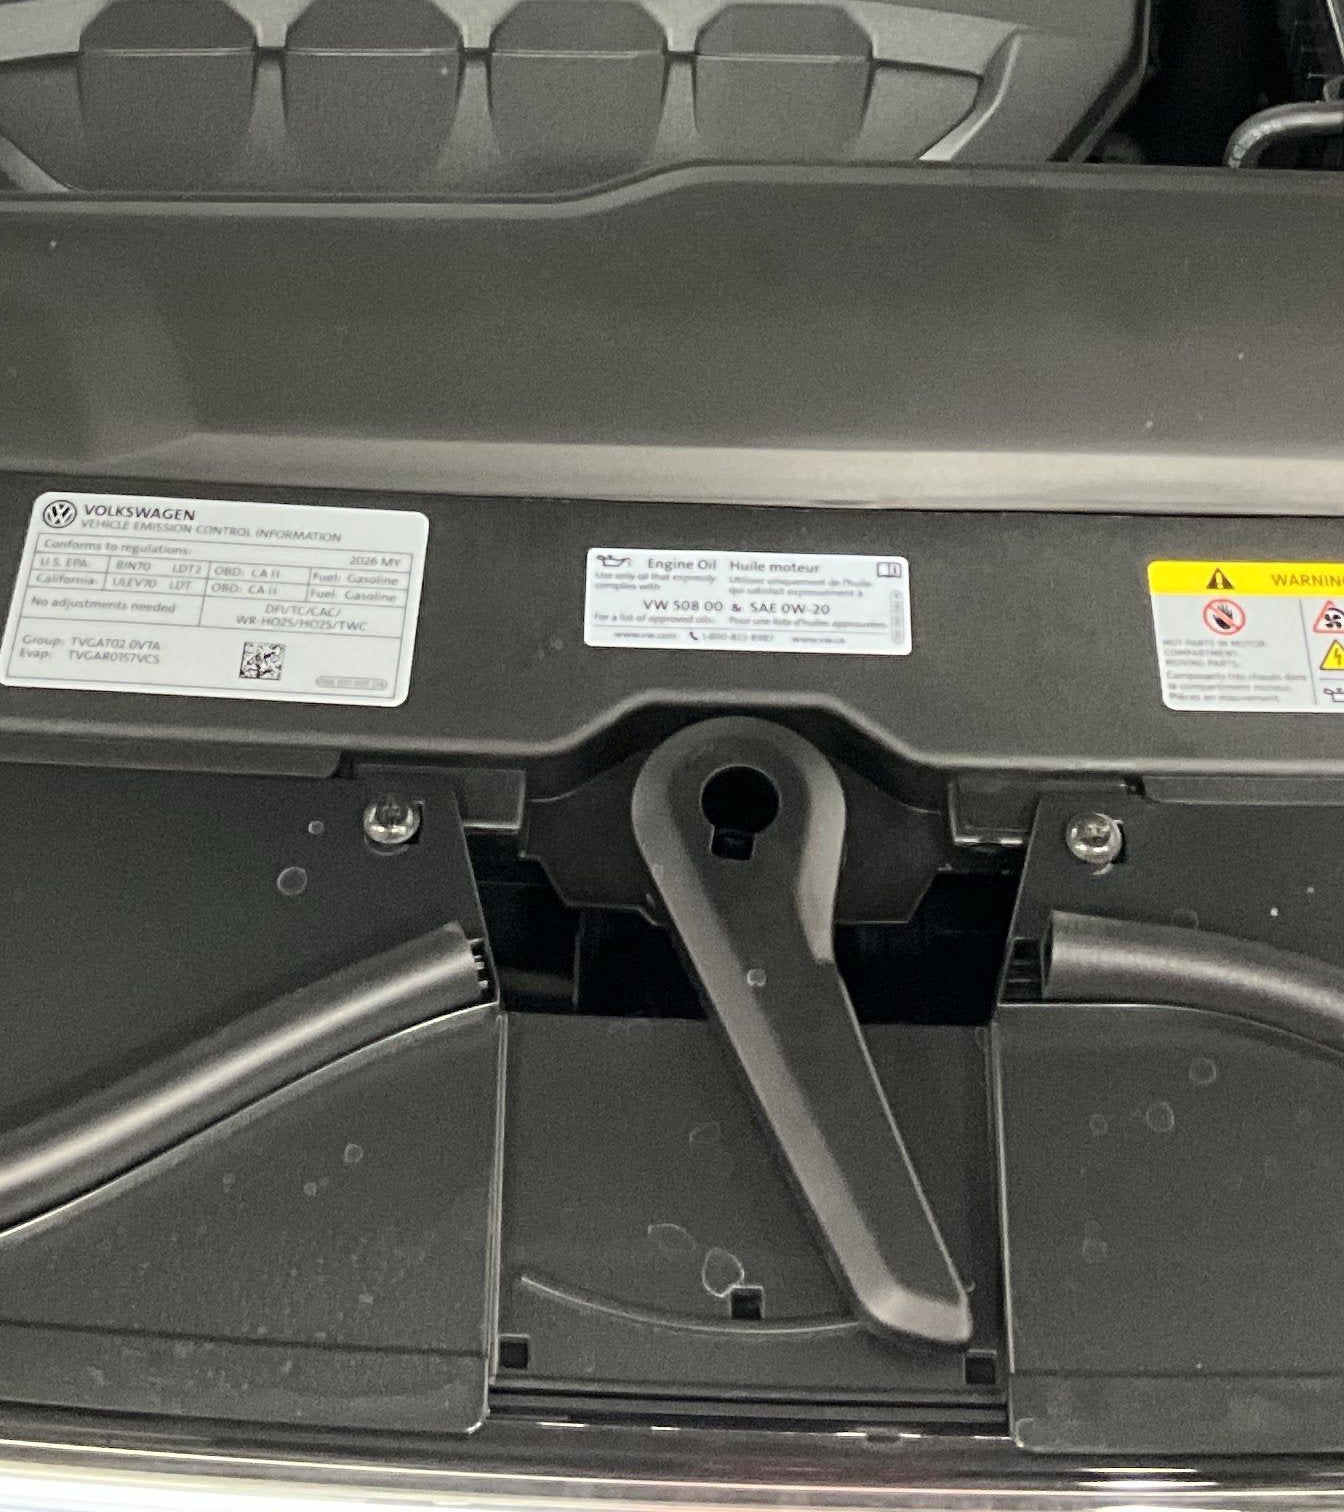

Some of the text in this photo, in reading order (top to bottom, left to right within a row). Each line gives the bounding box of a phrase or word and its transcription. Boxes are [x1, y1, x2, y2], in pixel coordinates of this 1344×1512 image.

[84, 504, 196, 521] VOLKSWAGEN
[80, 519, 343, 543] VEHICLE EMISSION CONTROL INFORMATION
[43, 538, 102, 552] Conforms
[105, 541, 117, 552] to
[115, 560, 152, 572] BIN70
[349, 555, 402, 568] 2026 MY
[647, 558, 717, 572] Engine Oil
[729, 560, 820, 573] Huile moteur
[172, 563, 203, 575] LDT2
[250, 568, 268, 578] CA
[112, 576, 158, 589] ULEV70
[169, 579, 192, 590] LDT
[312, 571, 399, 587] Fuel: Gasoline
[248, 584, 265, 595] CA
[344, 589, 397, 603] Gasoline
[31, 596, 177, 614] No adjustments needed
[642, 599, 723, 612] VW 508 00
[731, 603, 742, 612] &
[750, 603, 777, 614] SAE
